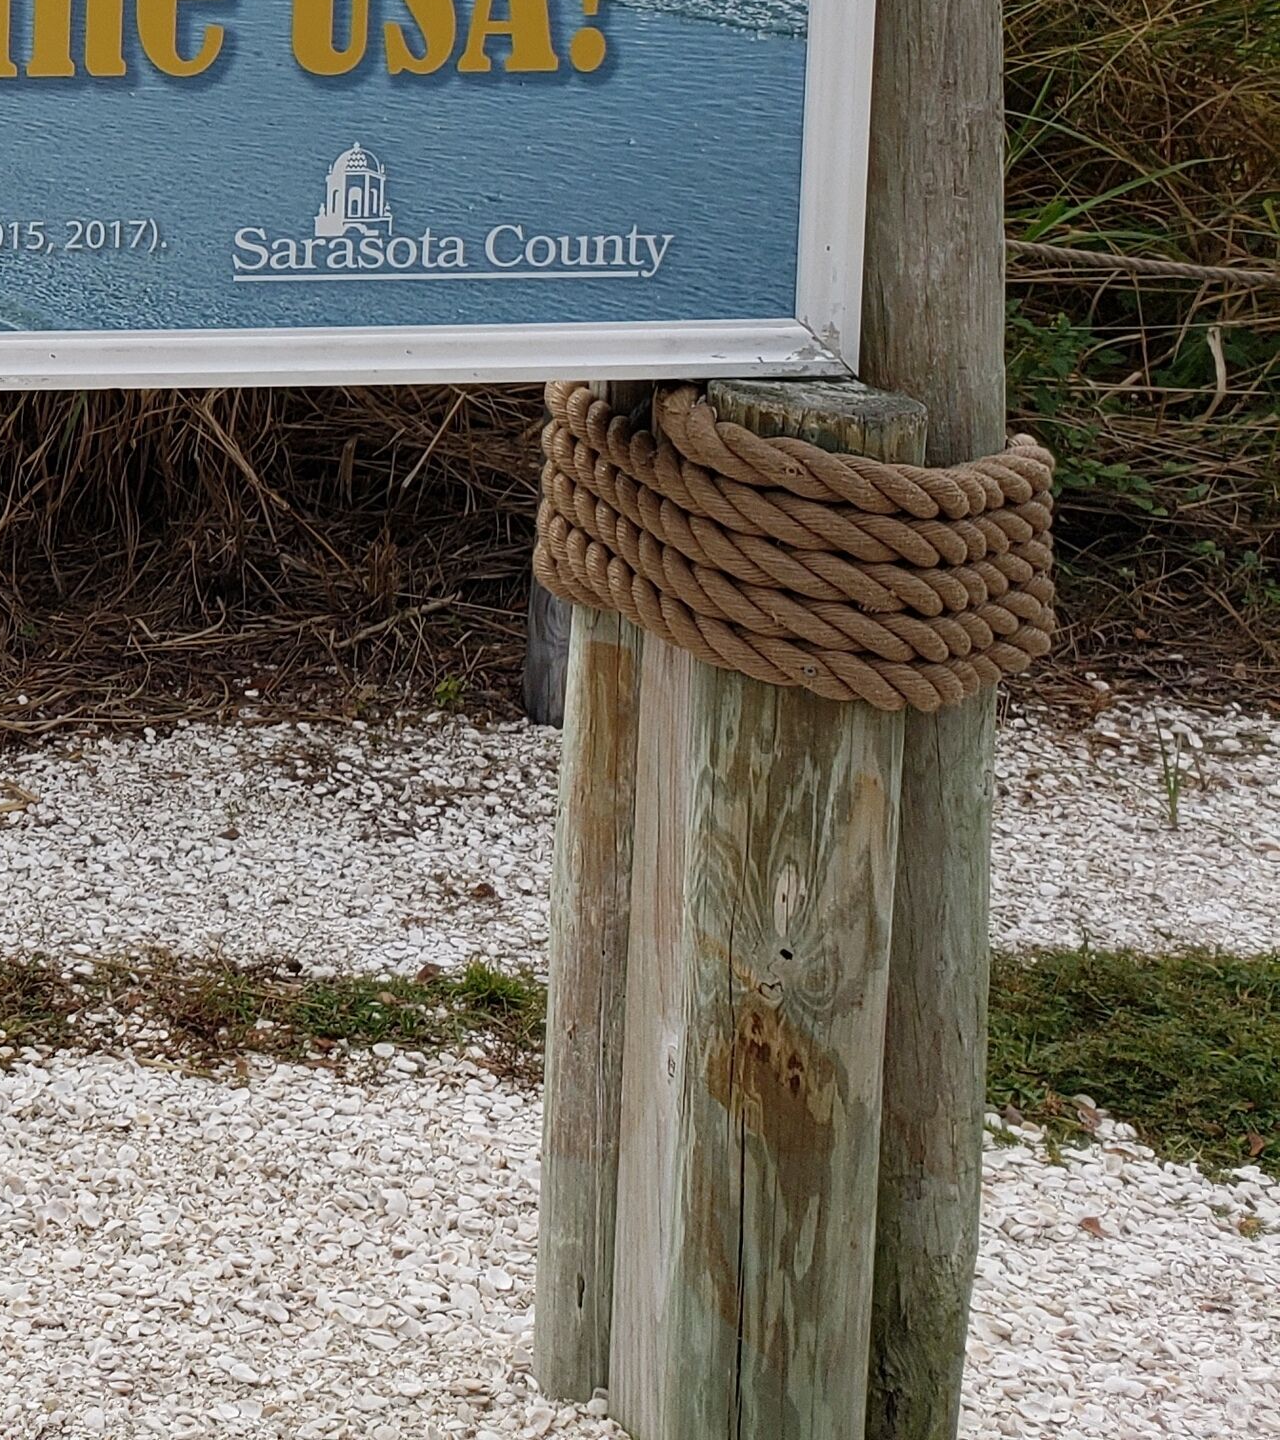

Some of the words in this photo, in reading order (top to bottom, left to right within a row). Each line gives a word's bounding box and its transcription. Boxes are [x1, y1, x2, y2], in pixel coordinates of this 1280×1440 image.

[63, 216, 168, 254] 2017).
[232, 226, 469, 271] Sarasota
[484, 223, 675, 277] County
